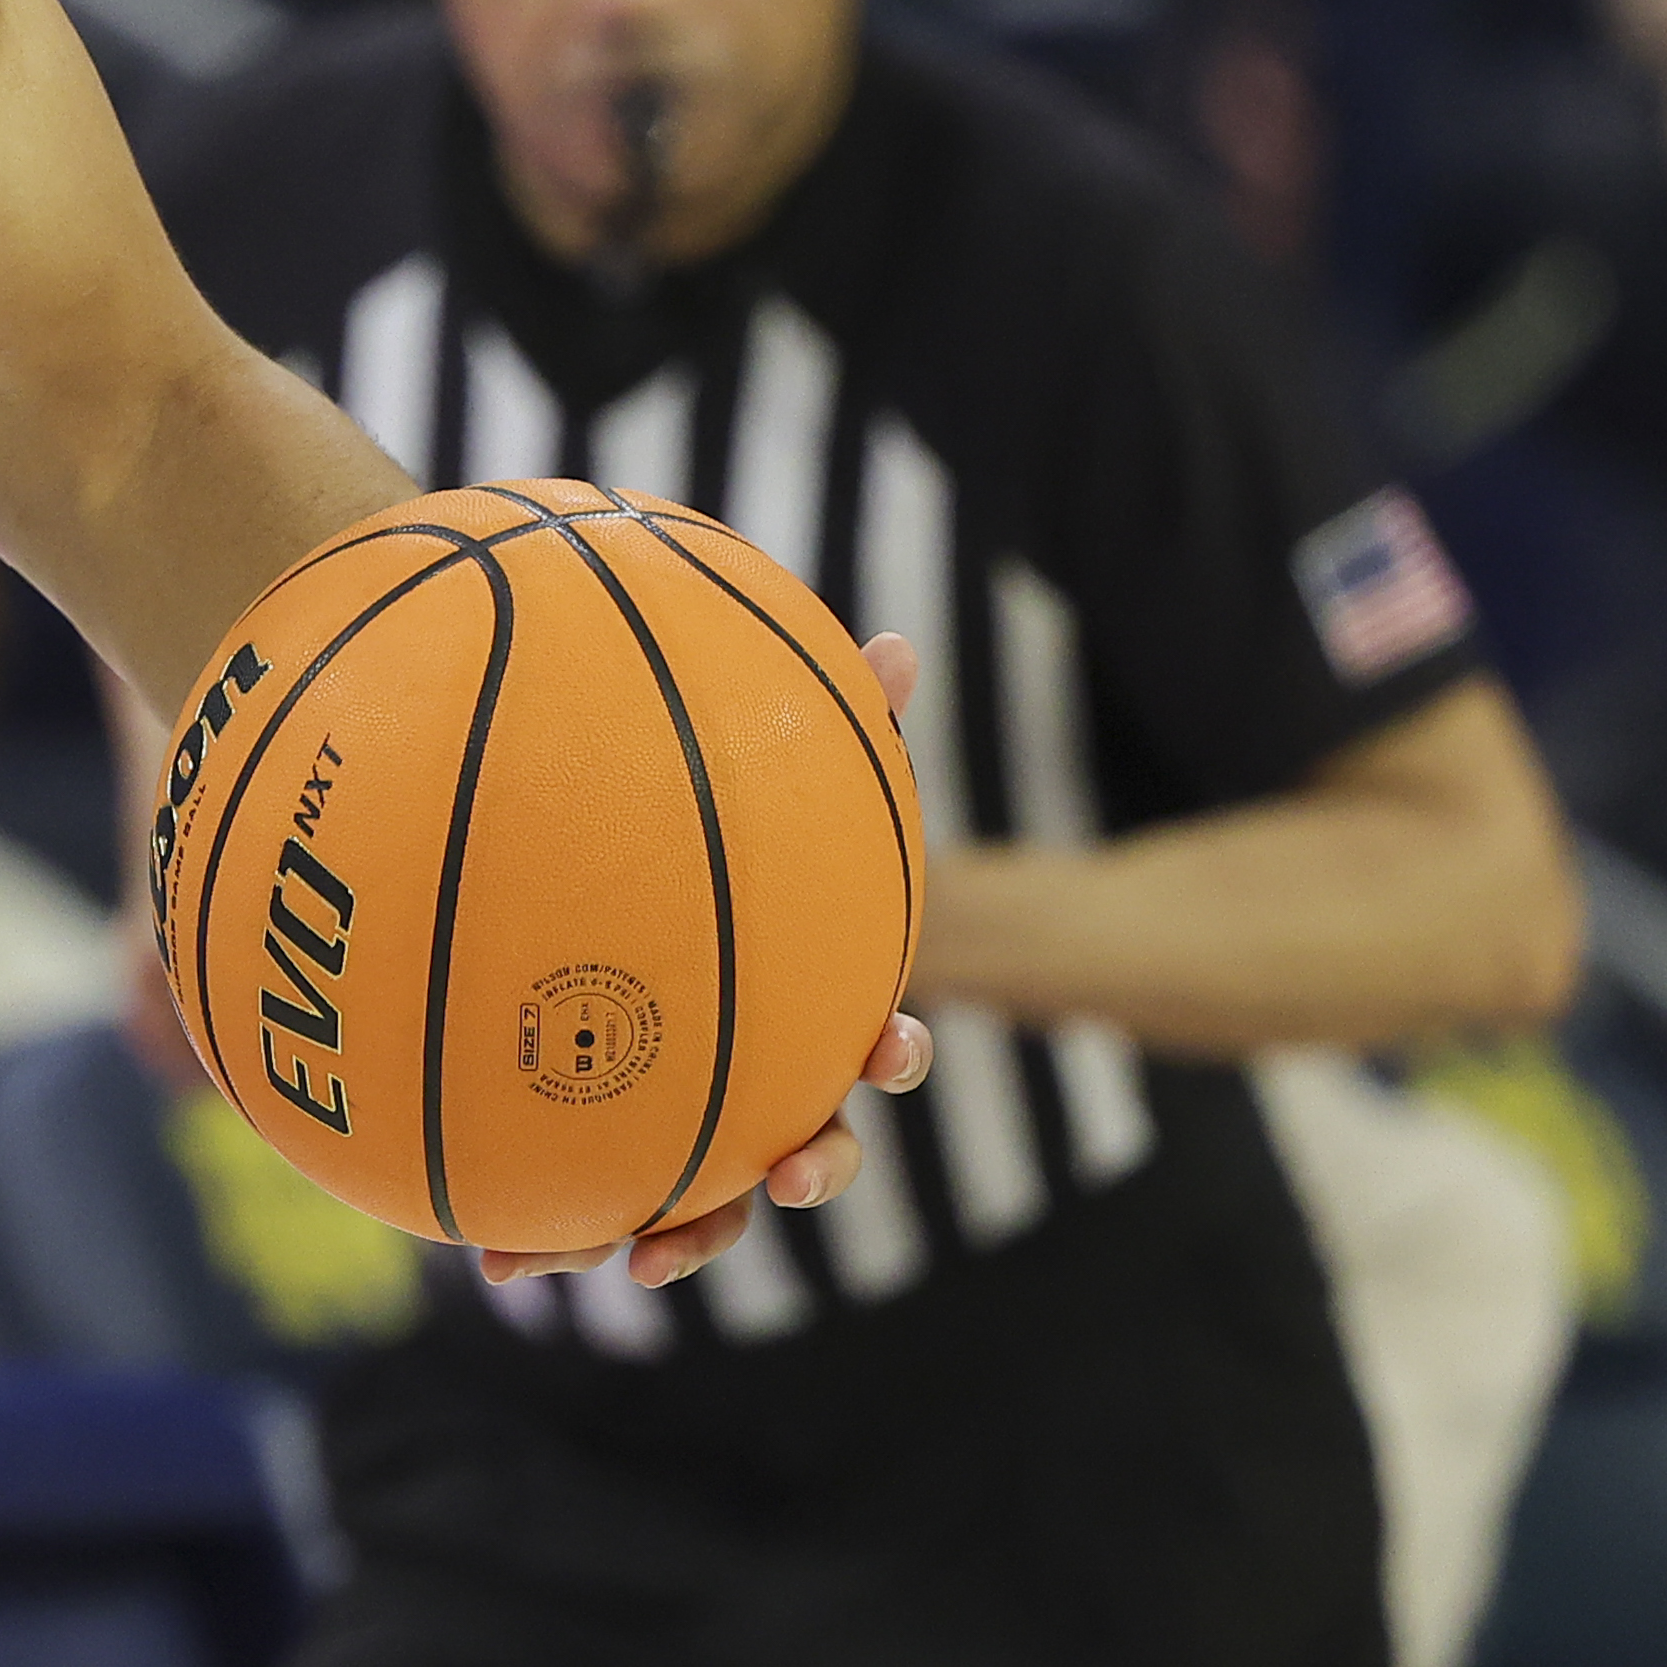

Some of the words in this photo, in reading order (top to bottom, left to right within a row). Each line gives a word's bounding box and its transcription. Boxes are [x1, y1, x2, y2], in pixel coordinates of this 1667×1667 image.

[293, 732, 343, 838] NXT
[171, 845, 184, 910] GAME
[183, 784, 207, 838] BALL
[259, 835, 356, 1138] EVO
[524, 1007, 537, 1020] 7
[647, 1000, 663, 1027] MADE
[522, 1026, 536, 1066] SIZE
